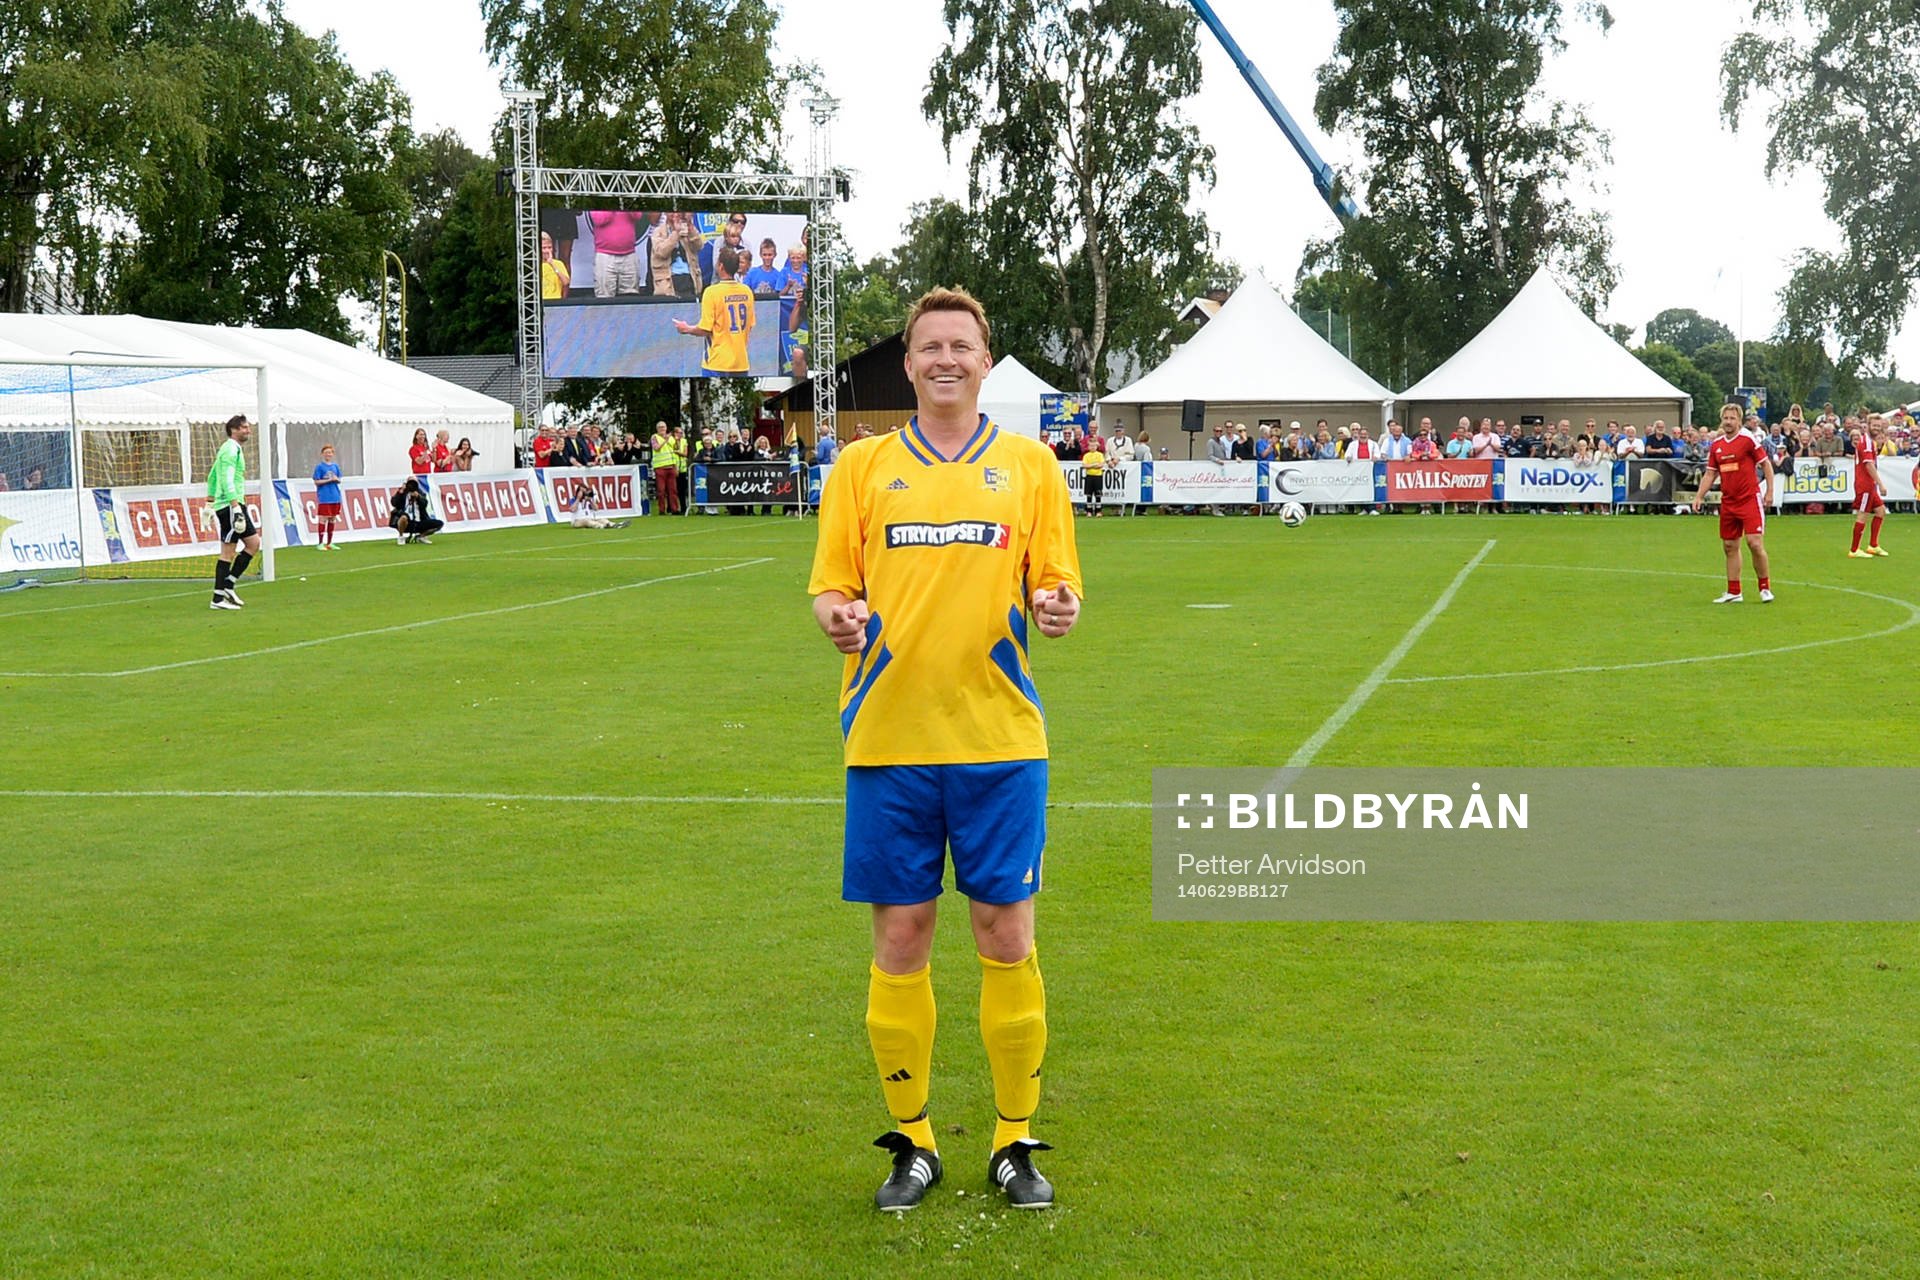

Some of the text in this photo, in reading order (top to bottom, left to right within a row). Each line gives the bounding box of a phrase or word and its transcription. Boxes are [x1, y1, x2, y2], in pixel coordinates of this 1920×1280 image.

[728, 303, 747, 332] 19
[728, 469, 783, 478] norrviken
[1395, 469, 1489, 489] KVÄLLSPOSTEN
[445, 482, 531, 514] CRAMO
[557, 483, 629, 505] CAMO
[720, 478, 793, 496] event.se
[891, 522, 986, 545] STRYKTIPSET
[10, 533, 81, 562] bravida
